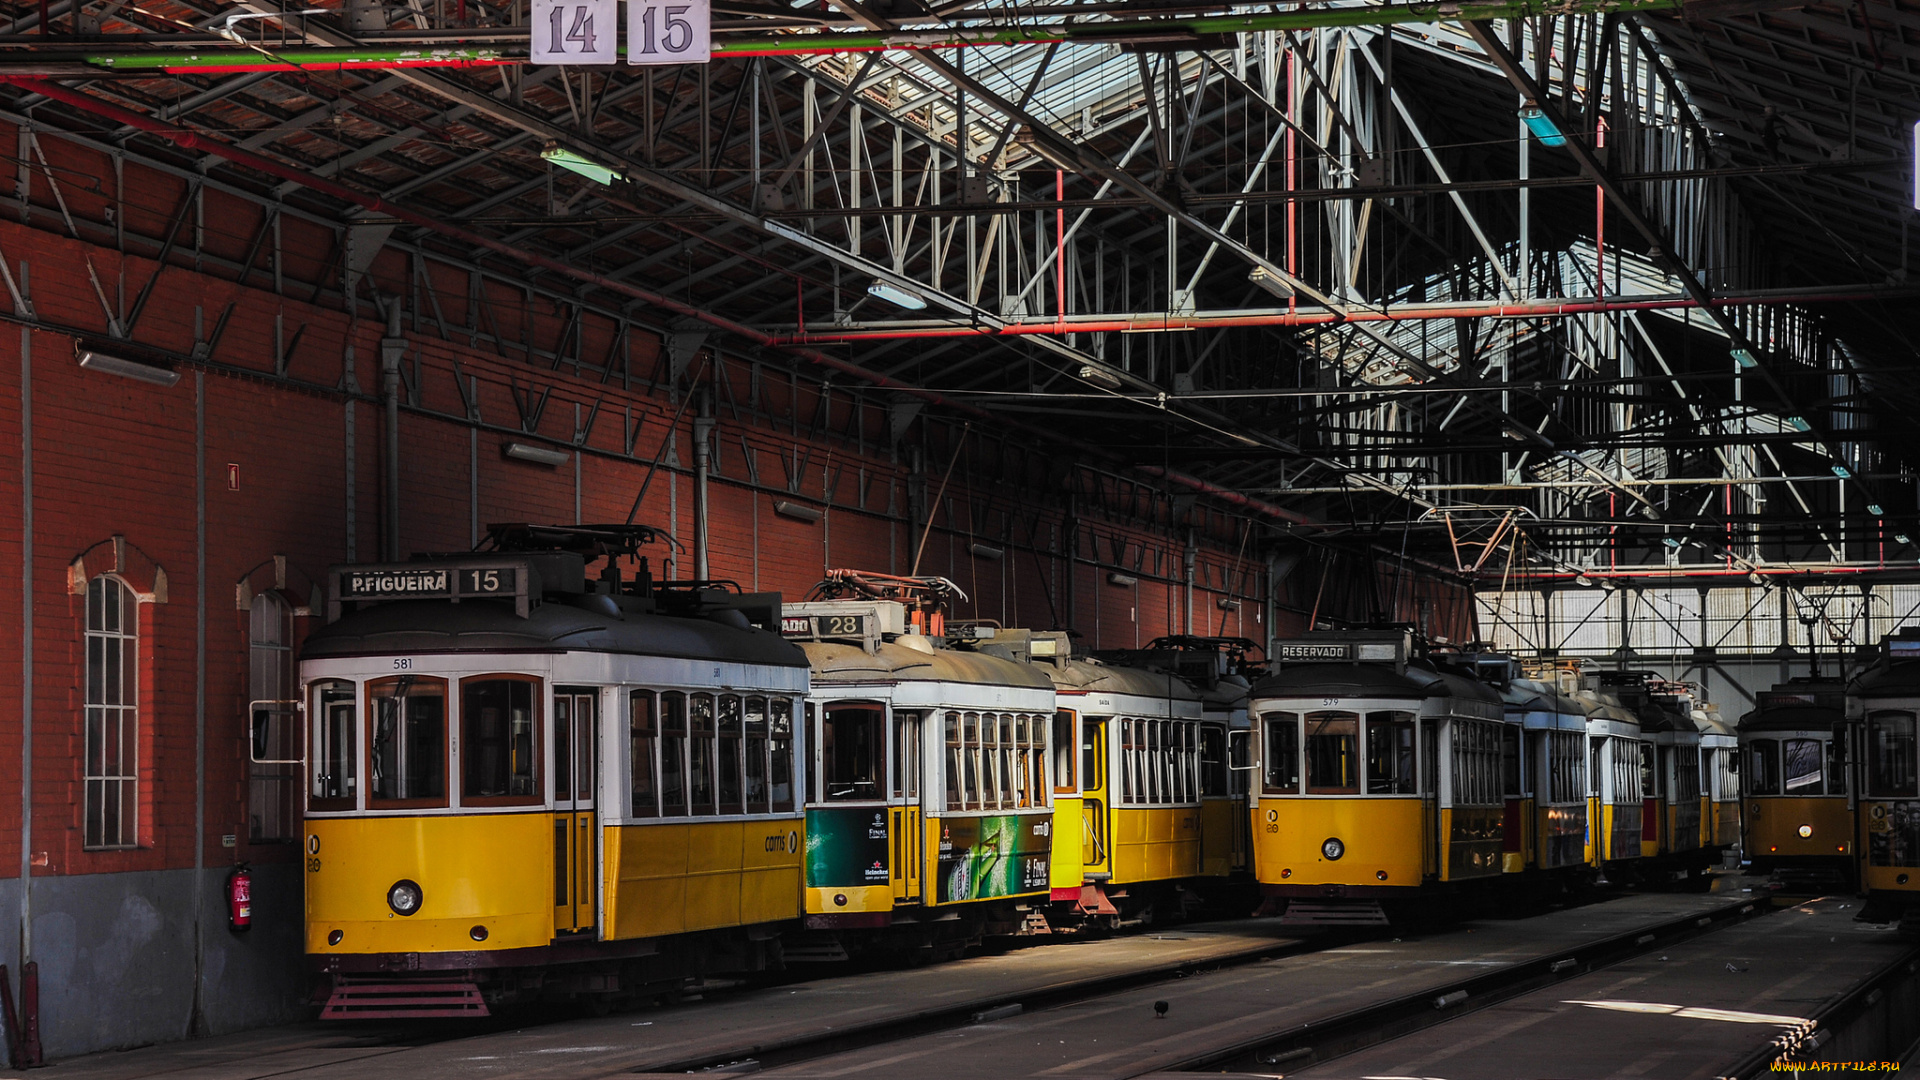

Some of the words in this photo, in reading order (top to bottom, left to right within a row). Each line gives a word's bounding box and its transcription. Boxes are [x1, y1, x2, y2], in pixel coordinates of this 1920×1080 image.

[548, 6, 598, 53] 14
[641, 6, 693, 54] 15
[352, 575, 447, 592] P.FIGUEIRA
[471, 570, 500, 592] 15
[830, 616, 857, 634] 28
[1282, 647, 1344, 657] RESERVADO
[393, 658, 412, 669] 581
[1323, 699, 1339, 707] 579
[765, 829, 785, 852] carris
